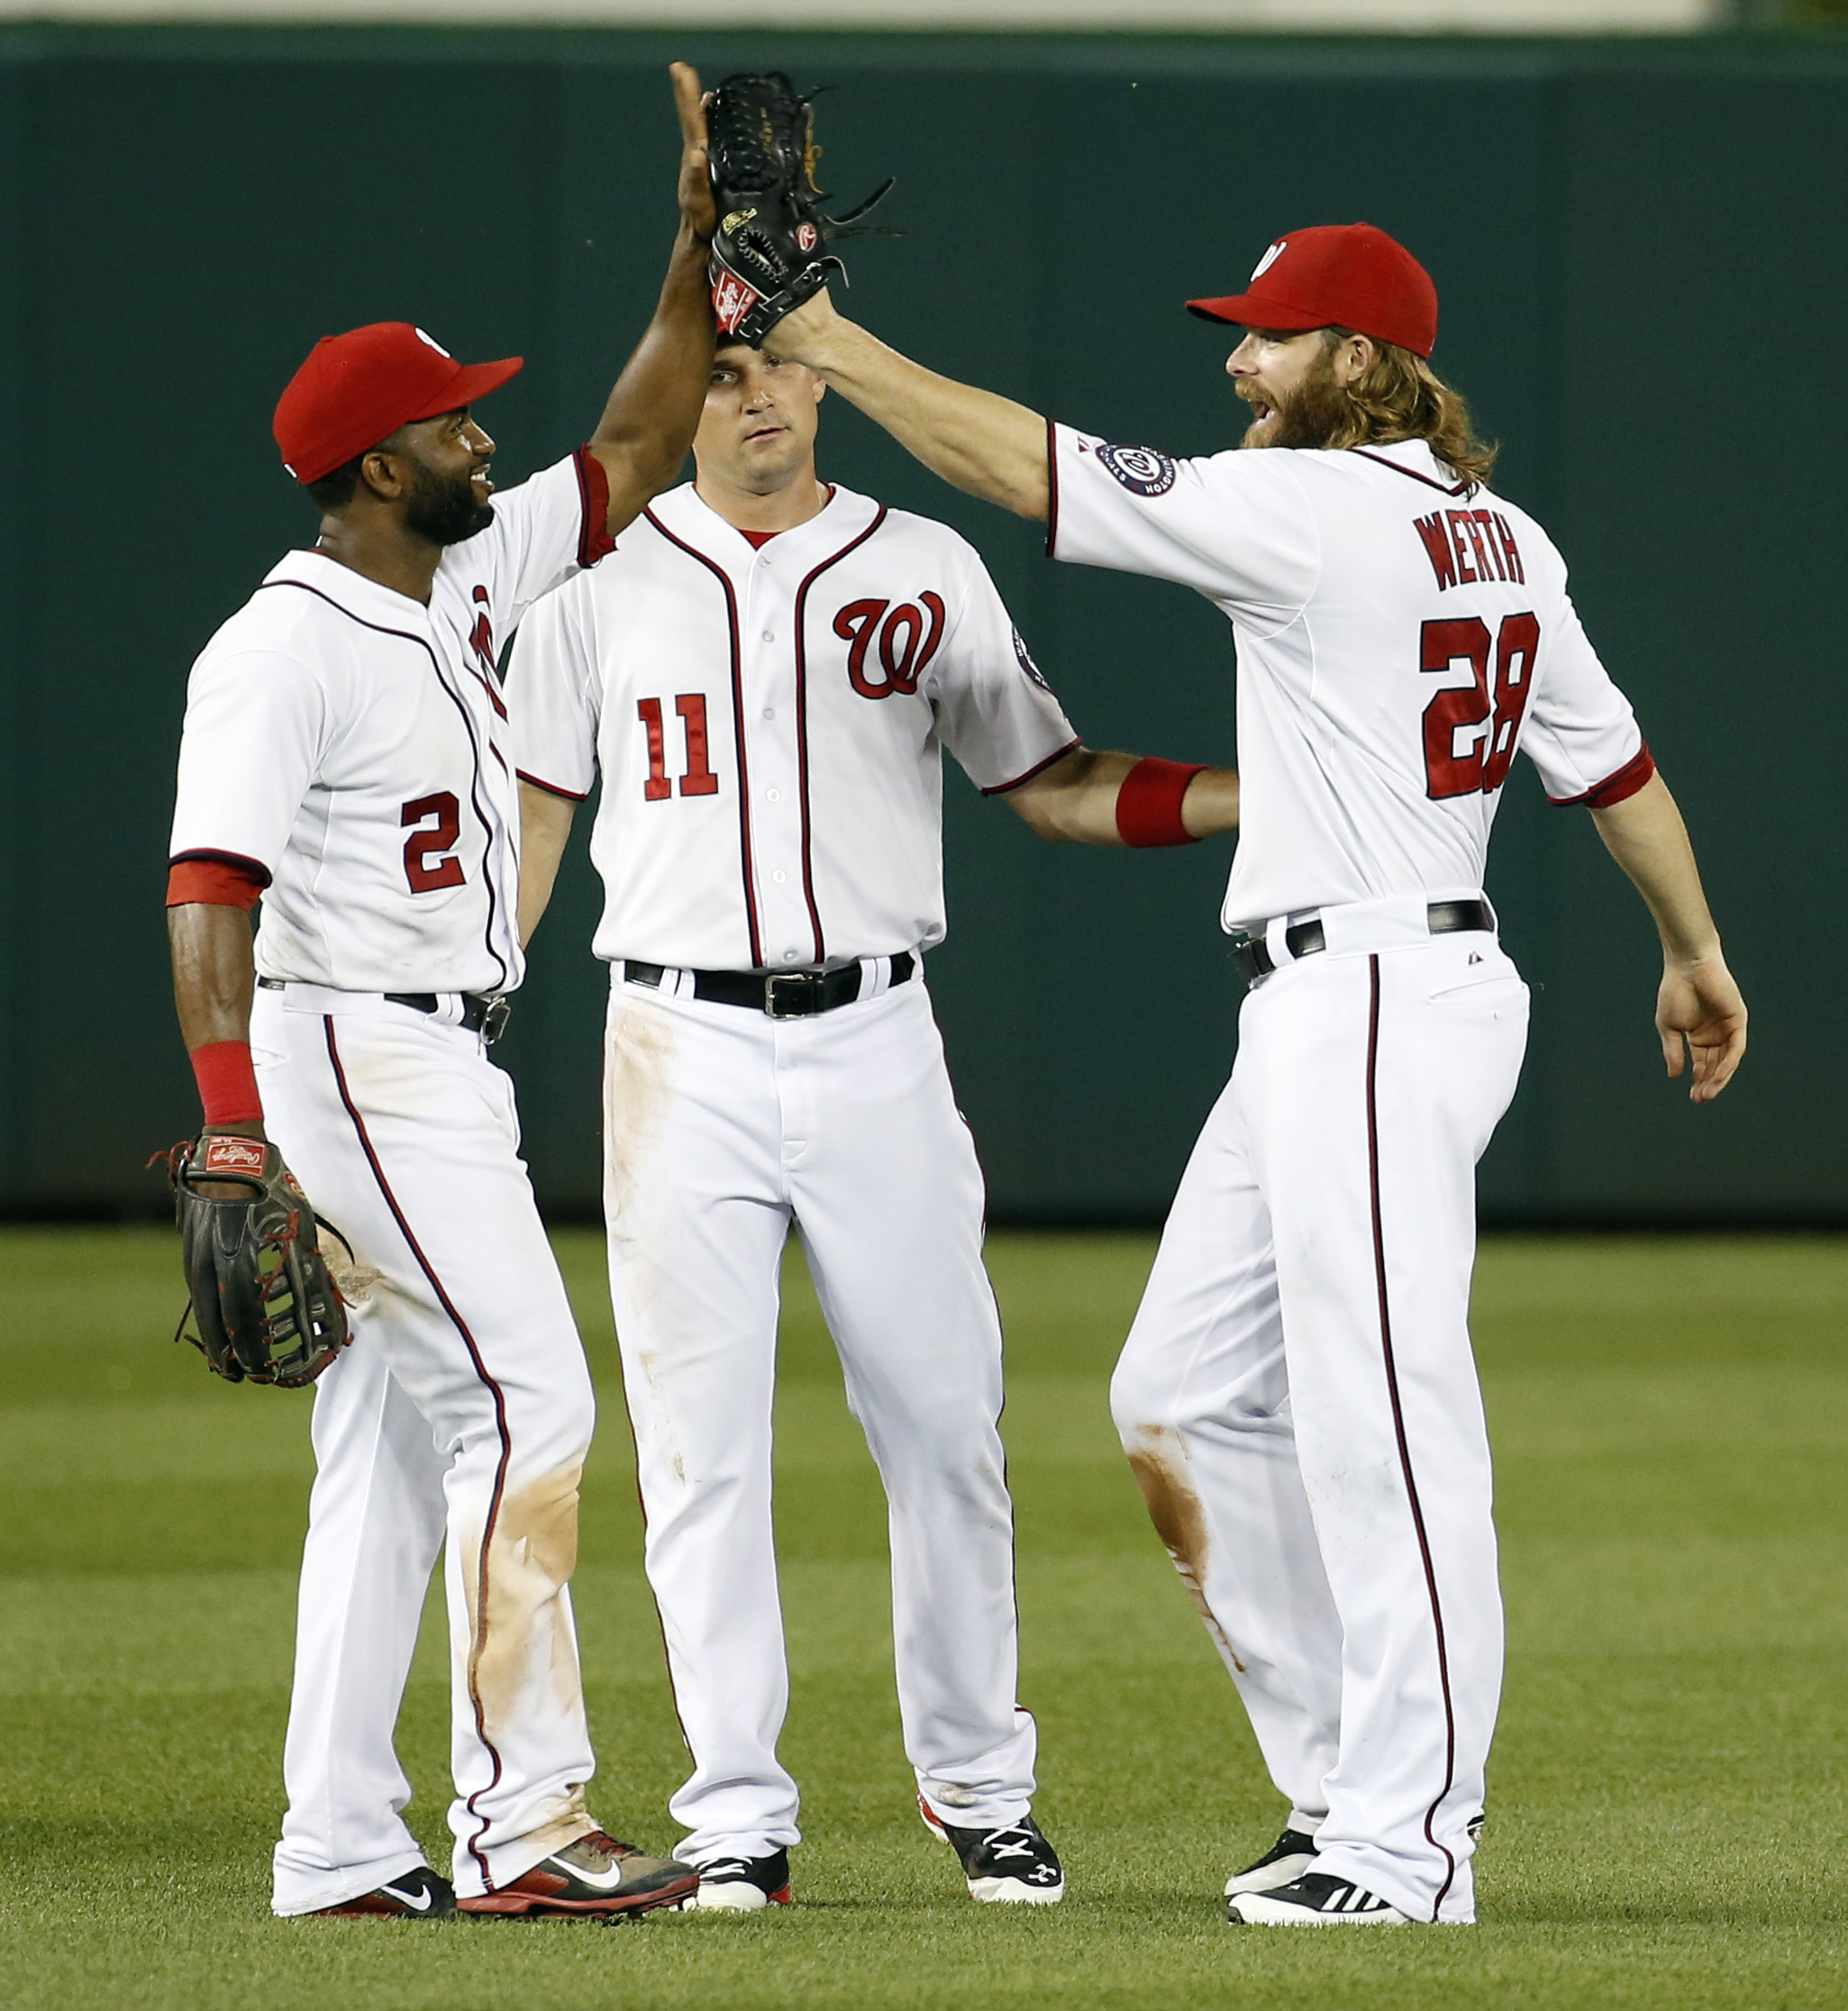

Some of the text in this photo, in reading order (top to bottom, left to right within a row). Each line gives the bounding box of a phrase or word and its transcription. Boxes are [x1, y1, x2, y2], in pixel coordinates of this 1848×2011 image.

[1141, 445, 1173, 494] WASHINGTON
[1413, 509, 1525, 592] WERTH
[833, 590, 946, 700] W
[637, 693, 719, 802] 11
[1419, 611, 1541, 800] 28
[400, 790, 467, 895] 2
